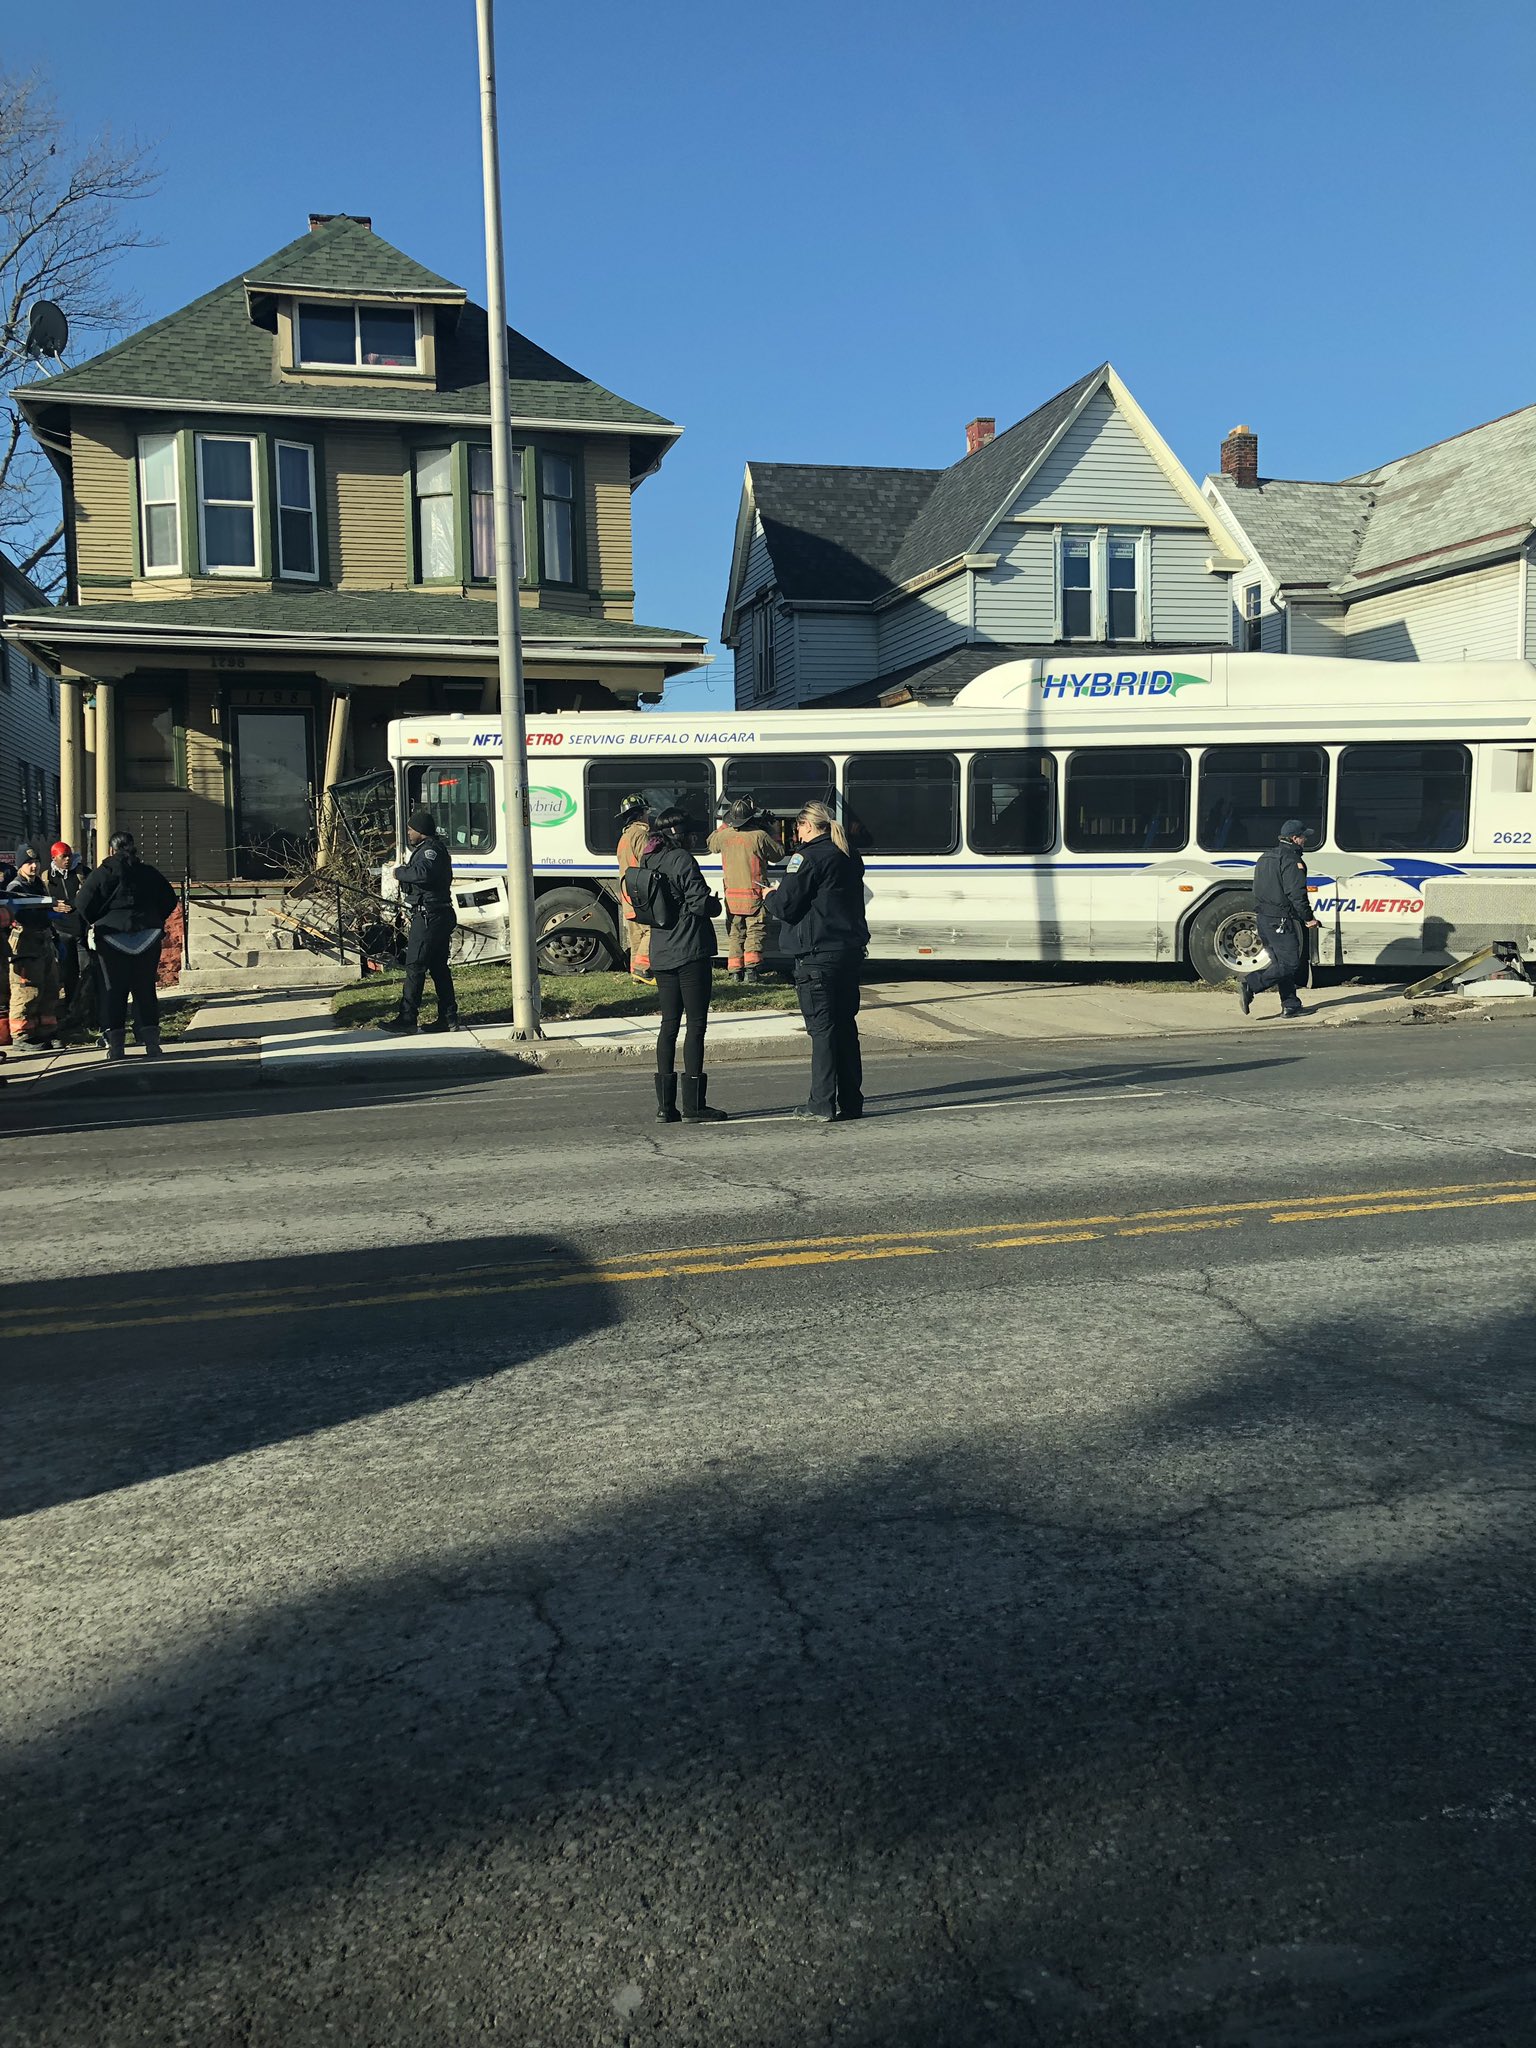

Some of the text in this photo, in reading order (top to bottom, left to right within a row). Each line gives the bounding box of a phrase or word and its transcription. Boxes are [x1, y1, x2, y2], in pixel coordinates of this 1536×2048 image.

[1042, 670, 1173, 699] HYBRID
[245, 690, 299, 704] 1798
[472, 732, 756, 746] NFTETRO SERVING BUFFALO NIAGARA
[527, 800, 563, 812] ybrid
[1493, 832, 1532, 844] 2622
[1313, 898, 1424, 913] NFTA-METRO
